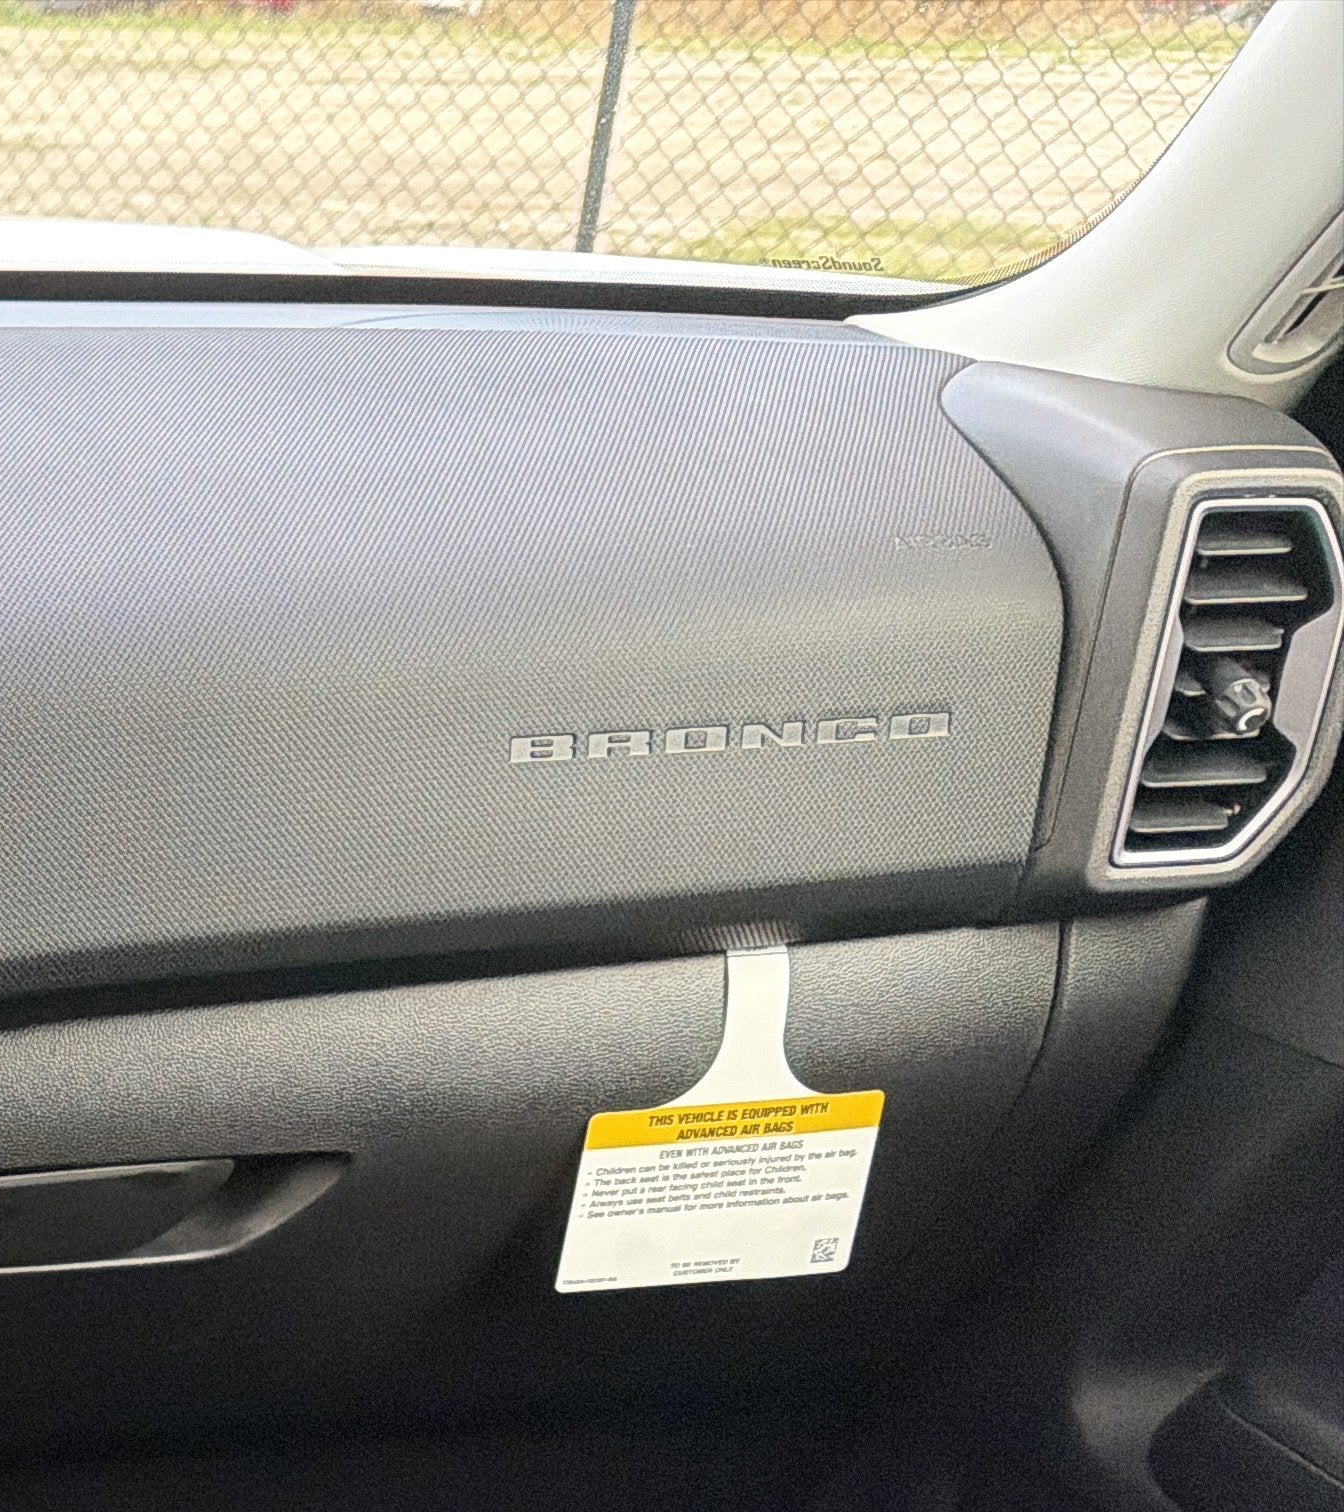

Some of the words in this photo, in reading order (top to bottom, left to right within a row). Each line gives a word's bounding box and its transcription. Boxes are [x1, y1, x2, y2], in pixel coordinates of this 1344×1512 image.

[510, 711, 951, 764] BRONCO
[648, 1114, 674, 1127] THIS
[678, 1110, 723, 1125] VEHICLE
[741, 1104, 797, 1120] EQUIPPED
[801, 1101, 829, 1116] WITH
[676, 1125, 738, 1141] ADVANCED
[740, 1123, 760, 1135] AIR
[763, 1120, 794, 1135] BAGS
[659, 1150, 683, 1160] EVEN
[686, 1148, 709, 1158] WITH
[711, 1143, 760, 1155] ADVANCED
[762, 1143, 778, 1151] AIR
[779, 1140, 804, 1150] BAGS
